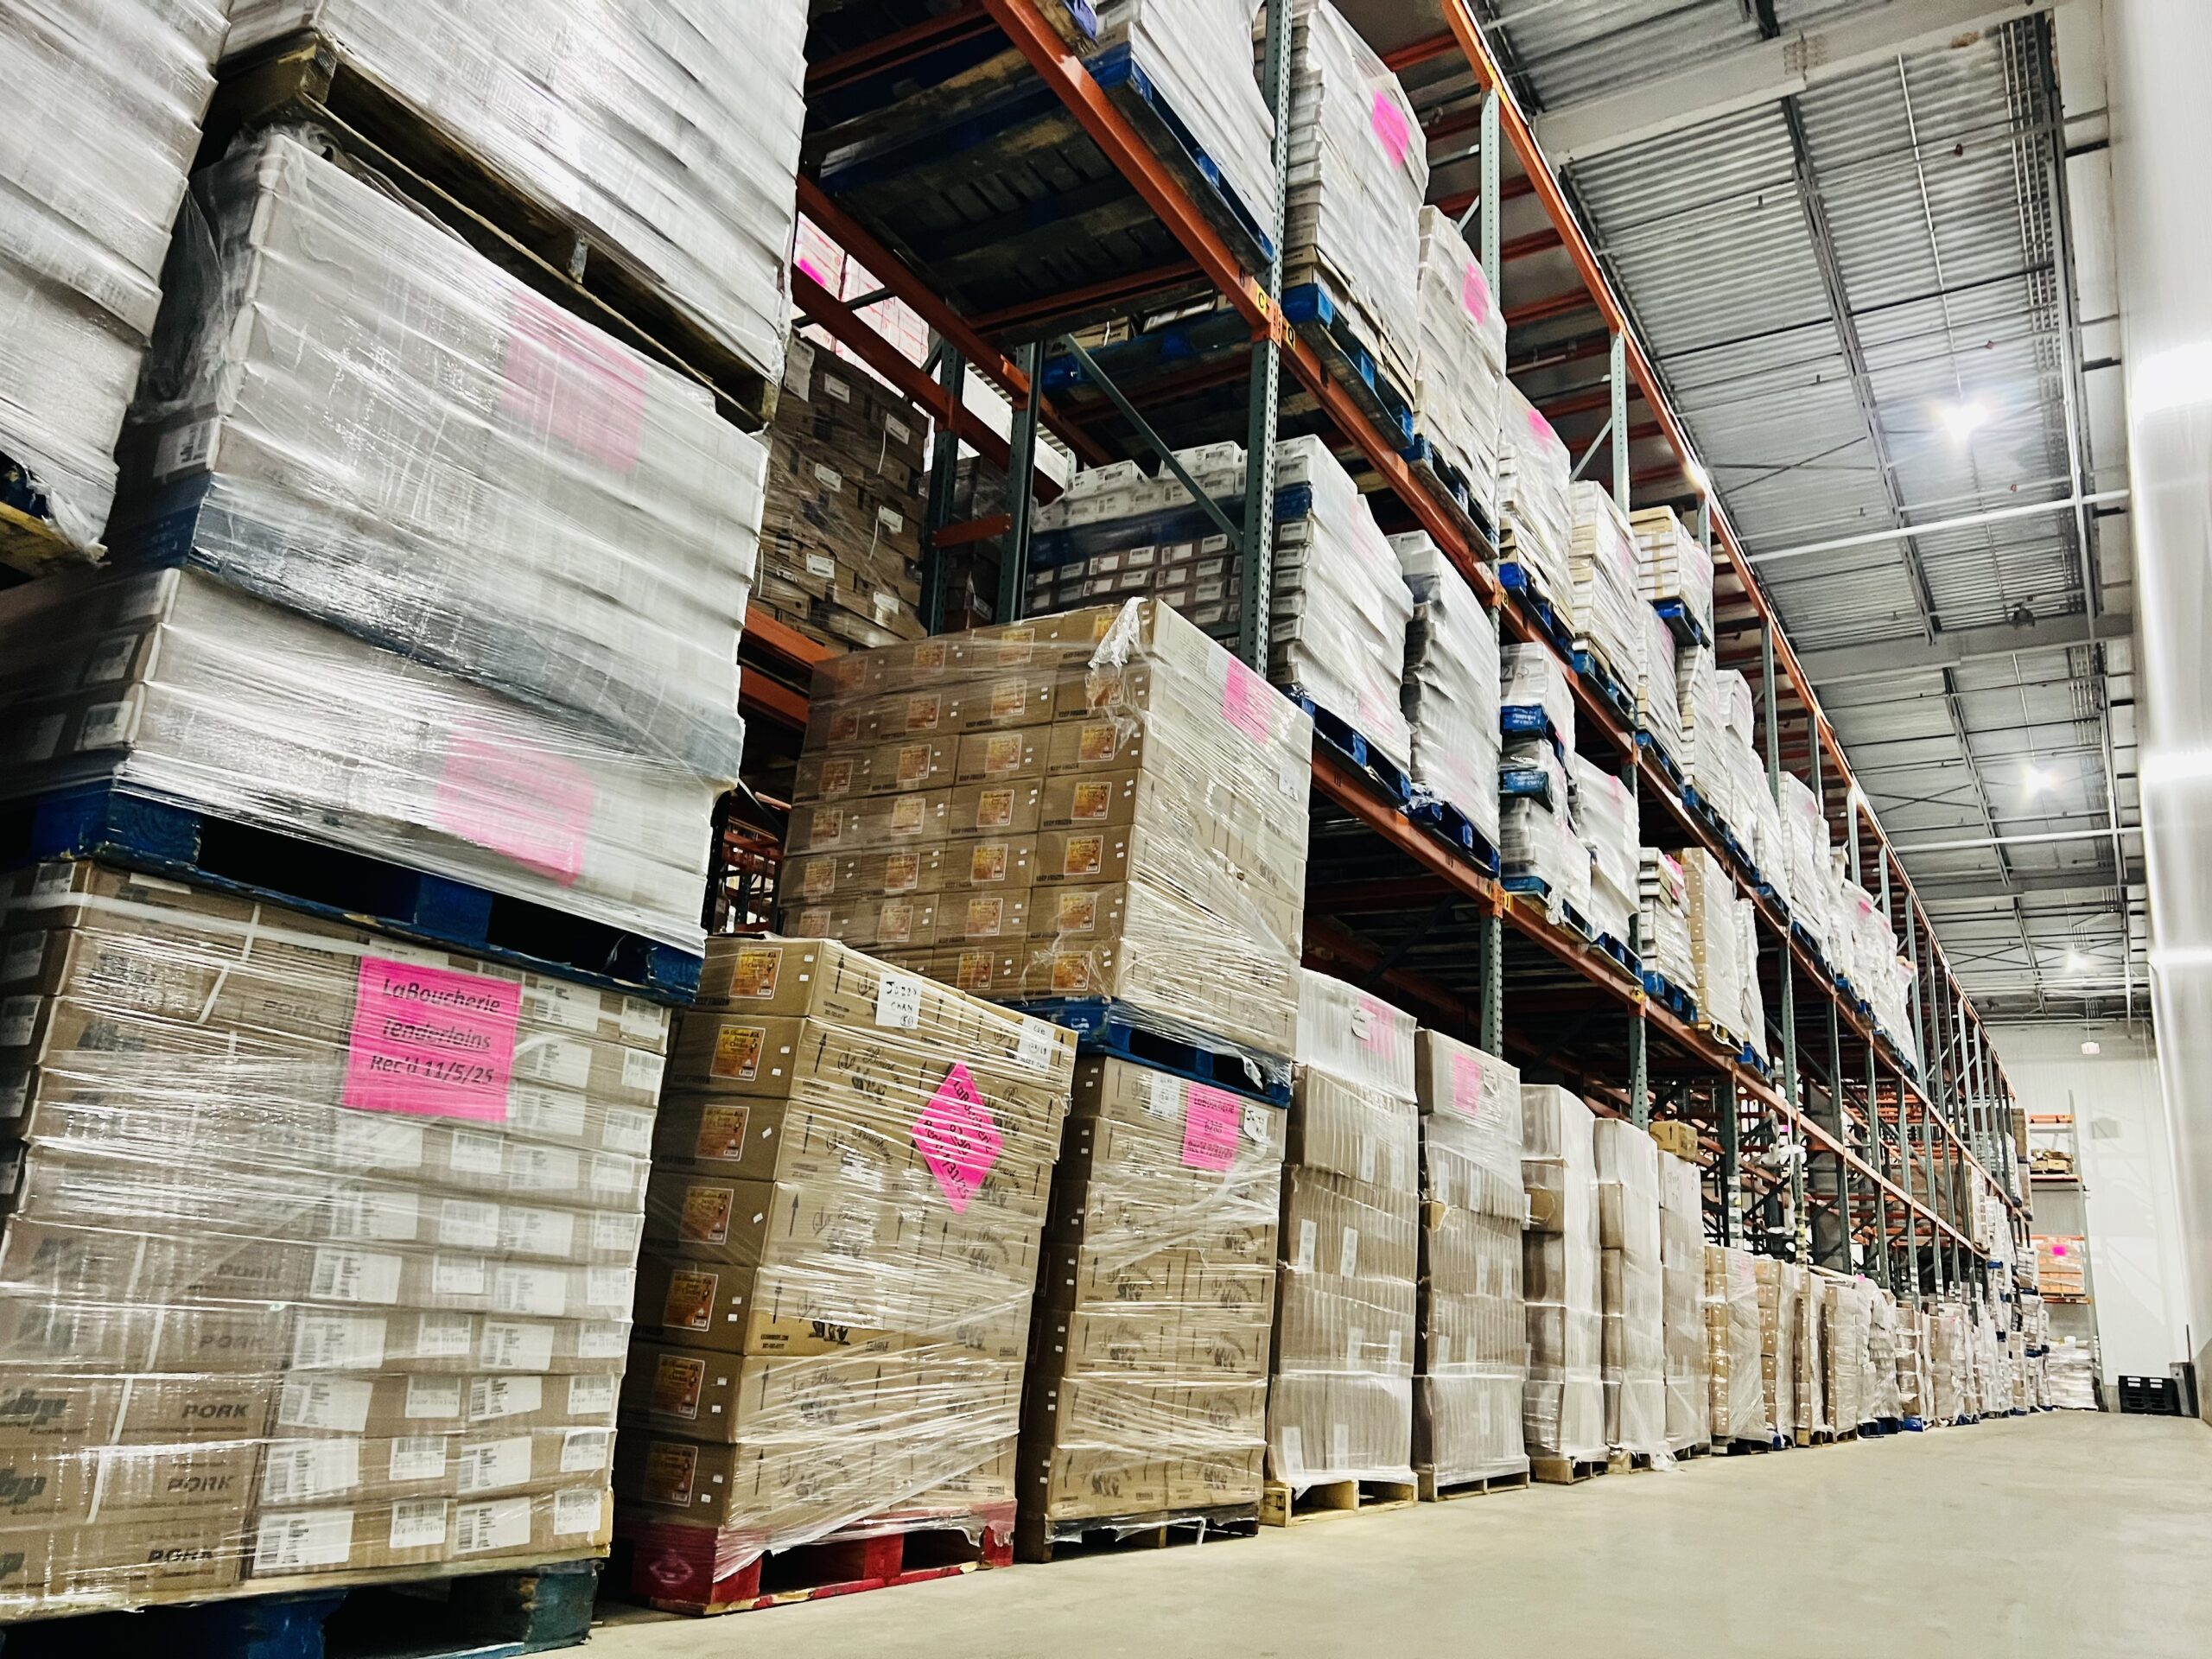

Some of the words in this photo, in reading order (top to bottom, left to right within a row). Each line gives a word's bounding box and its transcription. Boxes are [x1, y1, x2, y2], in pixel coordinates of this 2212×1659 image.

[383, 977, 502, 1014] LaBoucherie
[383, 1016, 492, 1050] Tenderloins
[370, 1054, 420, 1077] Rec'd
[424, 1059, 495, 1085] 11/5/25
[181, 1403, 249, 1419] PORK
[168, 1476, 234, 1492] PORK
